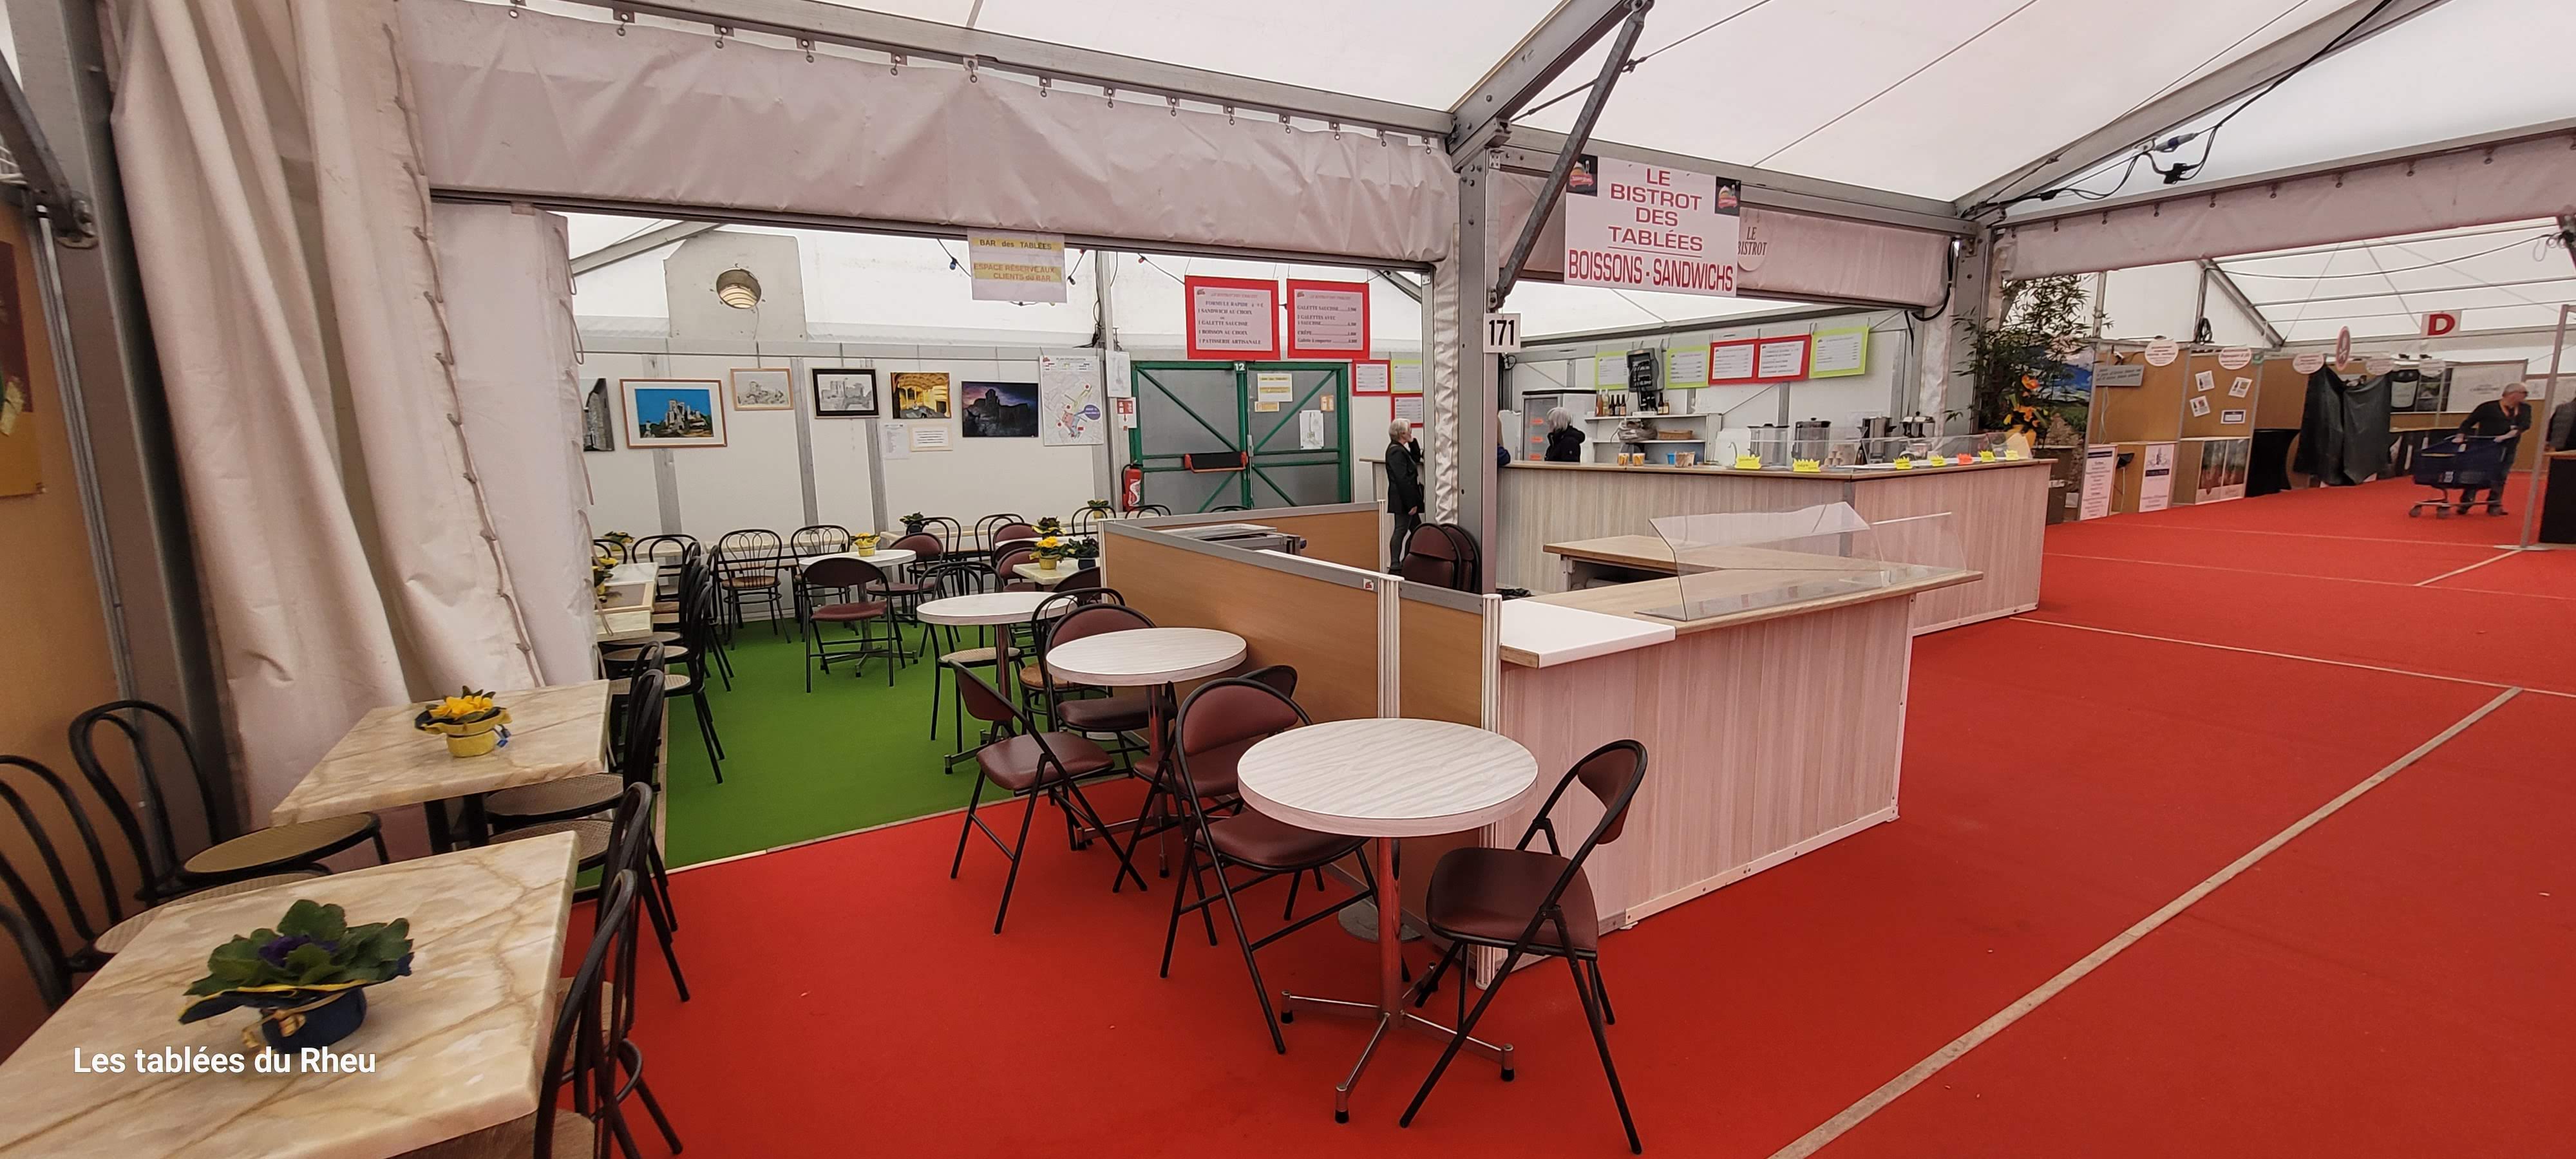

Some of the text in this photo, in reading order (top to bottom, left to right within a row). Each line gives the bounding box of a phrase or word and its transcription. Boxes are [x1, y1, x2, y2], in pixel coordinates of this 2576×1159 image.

[1646, 168, 1671, 187] LE
[1610, 184, 1703, 211] BISTROT
[1636, 207, 1678, 227] DES
[1608, 226, 1703, 252] TABLÉES
[1746, 226, 1757, 241] LE
[973, 263, 1004, 271] ESPACE
[1568, 249, 1643, 285] BOISSONS
[1653, 258, 1734, 292] SANDWICHS
[1489, 319, 1515, 346] 171
[2427, 314, 2456, 336] D
[1234, 363, 1245, 372] 12
